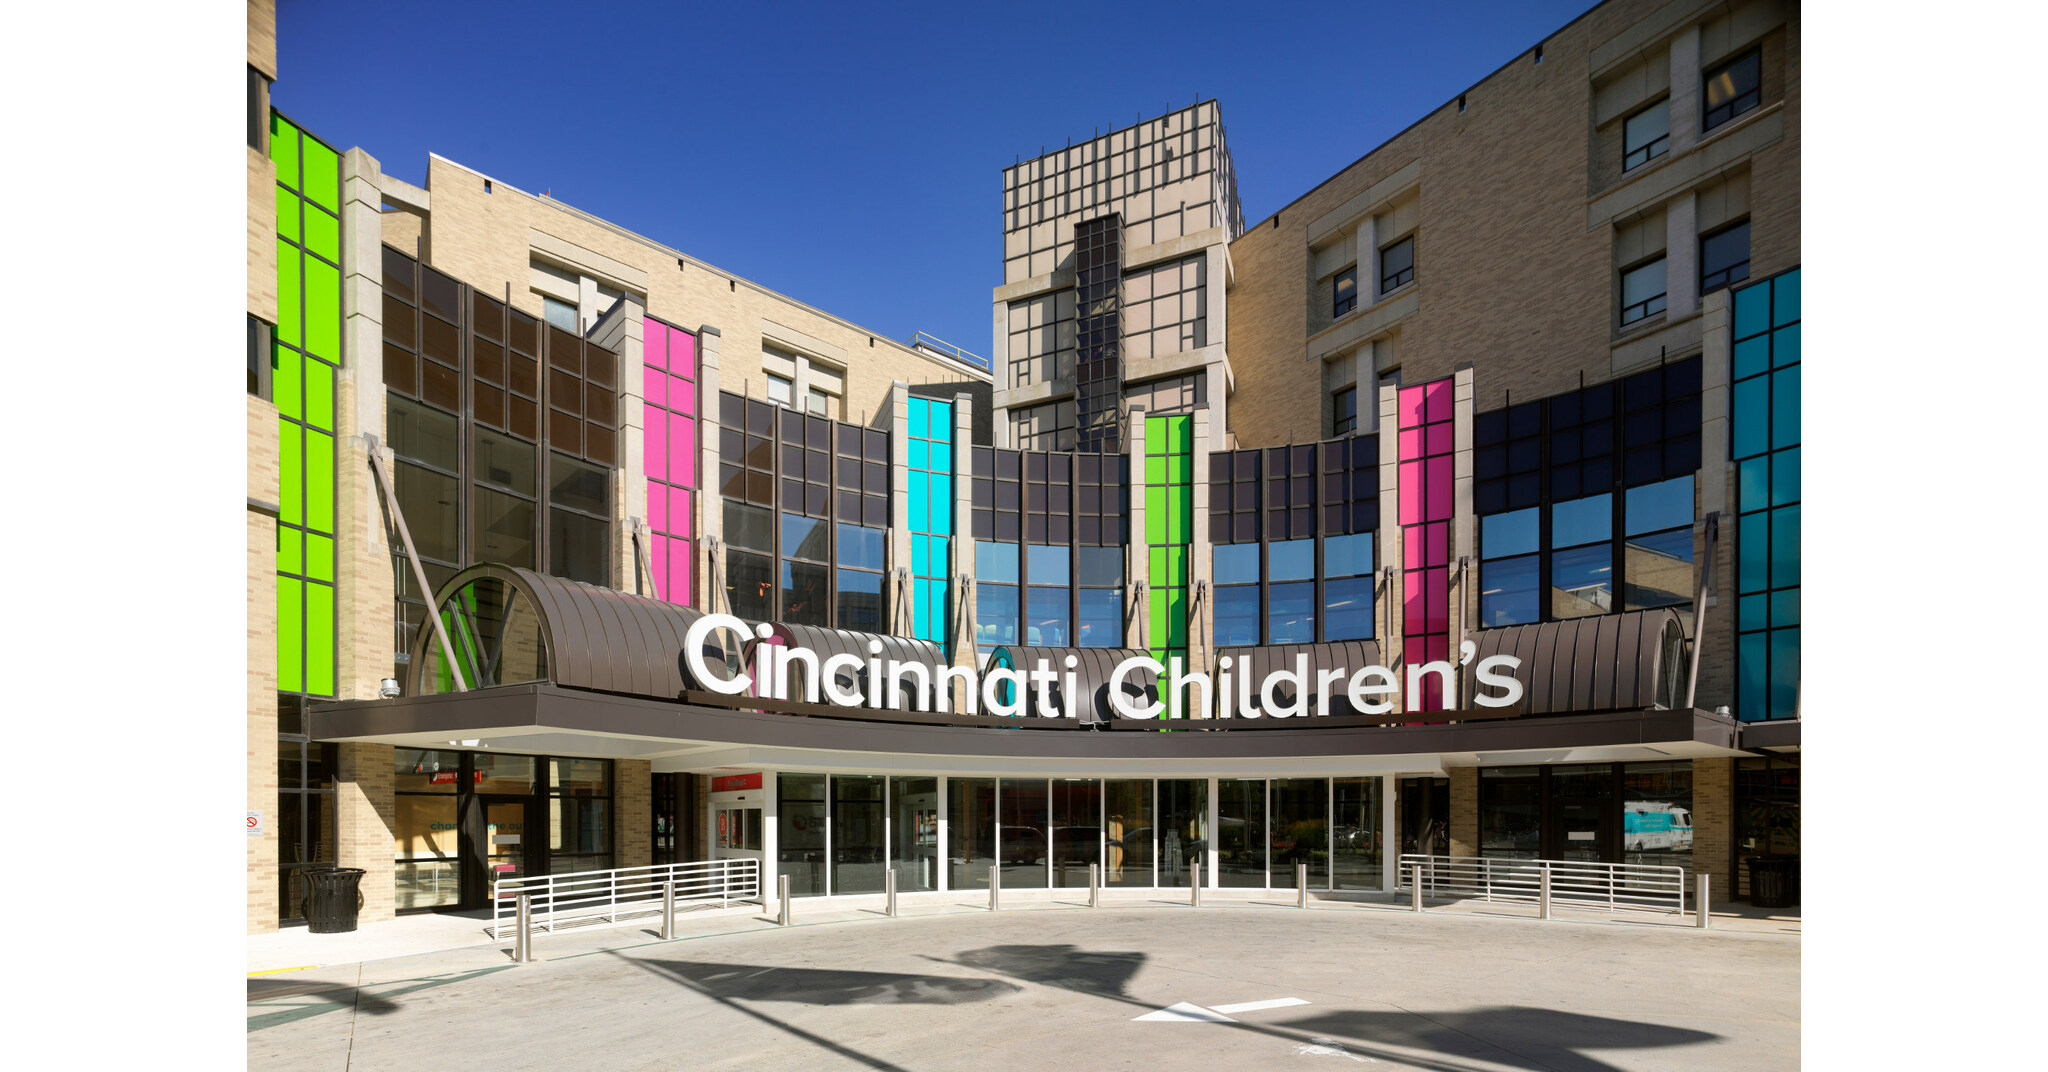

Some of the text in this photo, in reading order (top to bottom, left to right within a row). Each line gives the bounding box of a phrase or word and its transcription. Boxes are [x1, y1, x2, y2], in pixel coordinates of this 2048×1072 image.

[685, 613, 1523, 720] Cincinnati Children’s
[488, 822, 505, 830] the
